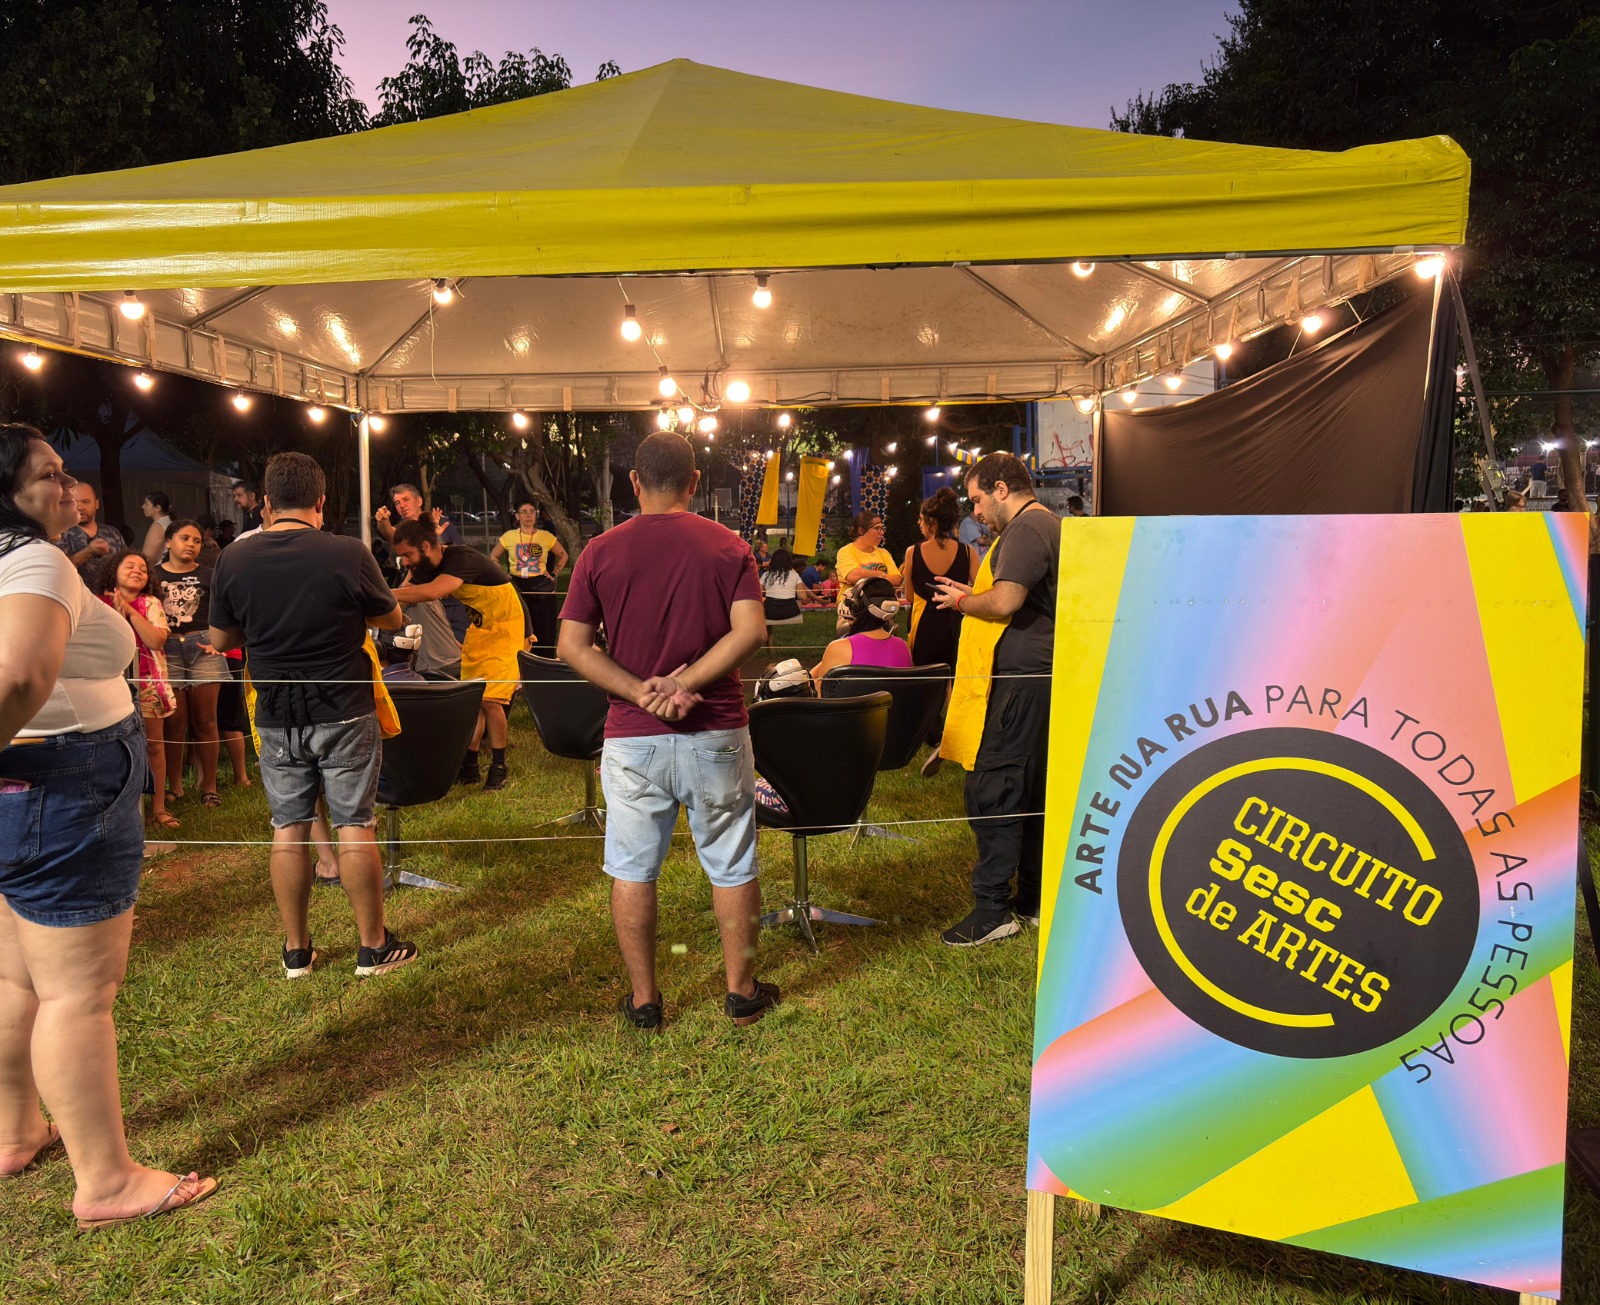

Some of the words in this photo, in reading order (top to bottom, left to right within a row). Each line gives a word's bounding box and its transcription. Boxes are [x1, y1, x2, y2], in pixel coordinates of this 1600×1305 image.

[1163, 690, 1254, 743] RUA
[1265, 684, 1368, 728] PARA
[1109, 736, 1169, 791] NA
[1390, 709, 1516, 837] TODAS
[1074, 791, 1121, 896] ARTE
[1209, 838, 1343, 932] Sesc
[1233, 796, 1444, 926] CIRCUITO
[1489, 851, 1534, 901] AS
[1185, 882, 1238, 931] de
[1236, 909, 1391, 1013] ARTES
[1399, 919, 1533, 1084] PESSOAS
